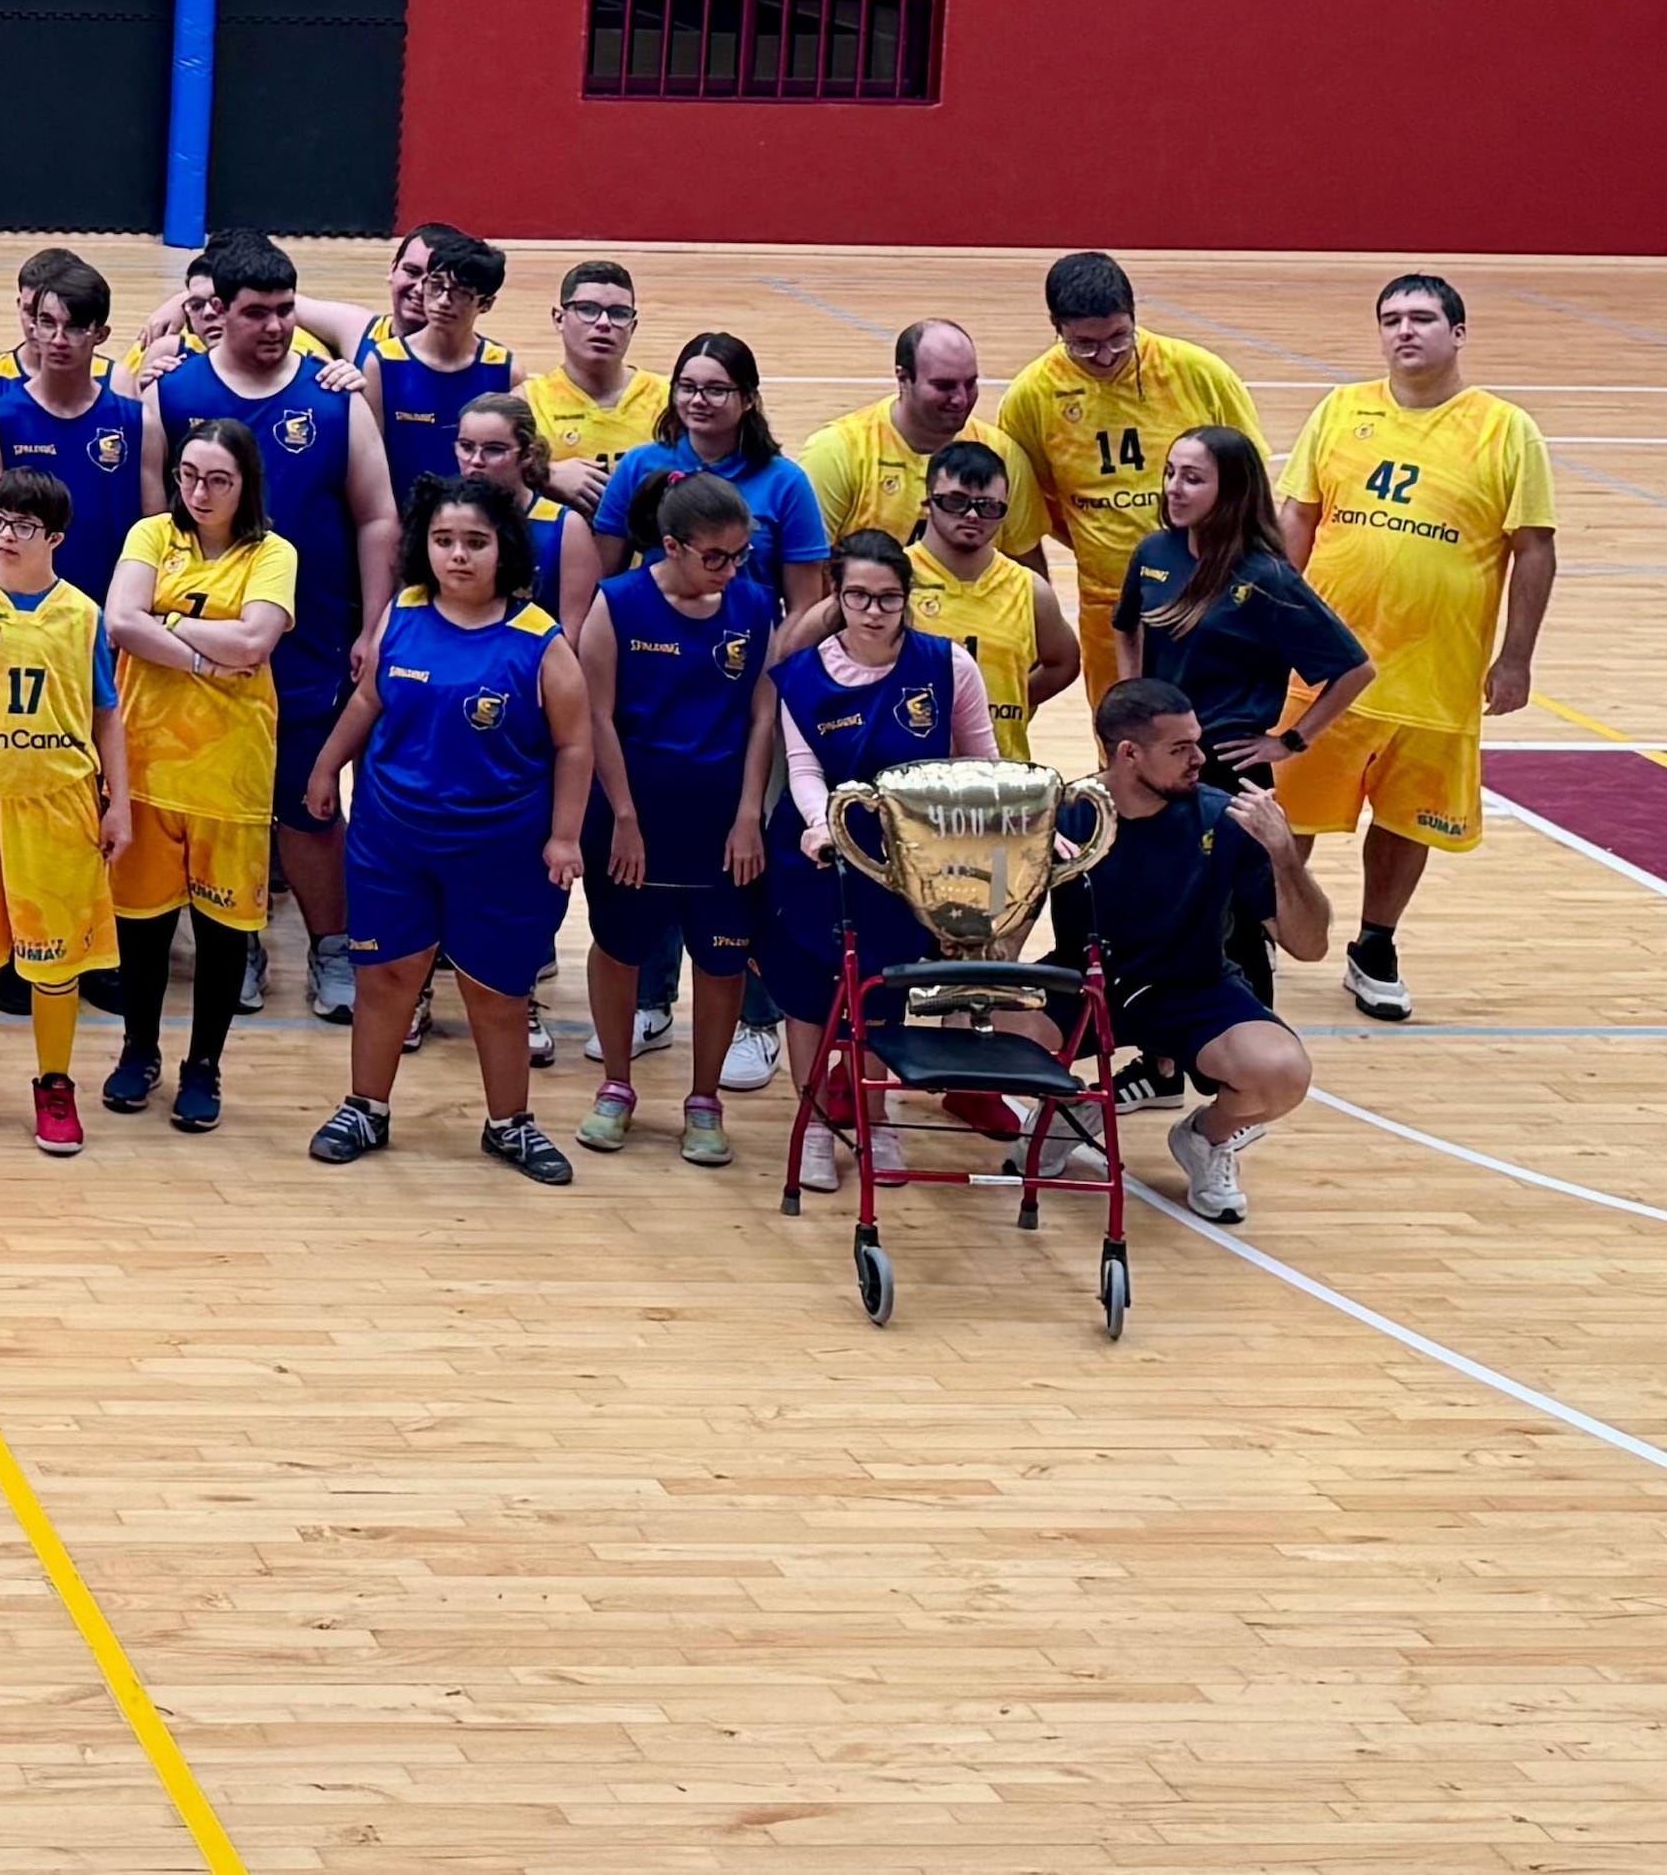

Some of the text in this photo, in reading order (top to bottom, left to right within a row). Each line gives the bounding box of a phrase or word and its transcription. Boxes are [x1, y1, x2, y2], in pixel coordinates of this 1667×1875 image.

[1095, 427, 1146, 475] 14
[1365, 459, 1421, 505] 42
[1369, 510, 1460, 545] Canaria
[7, 667, 47, 715] 17
